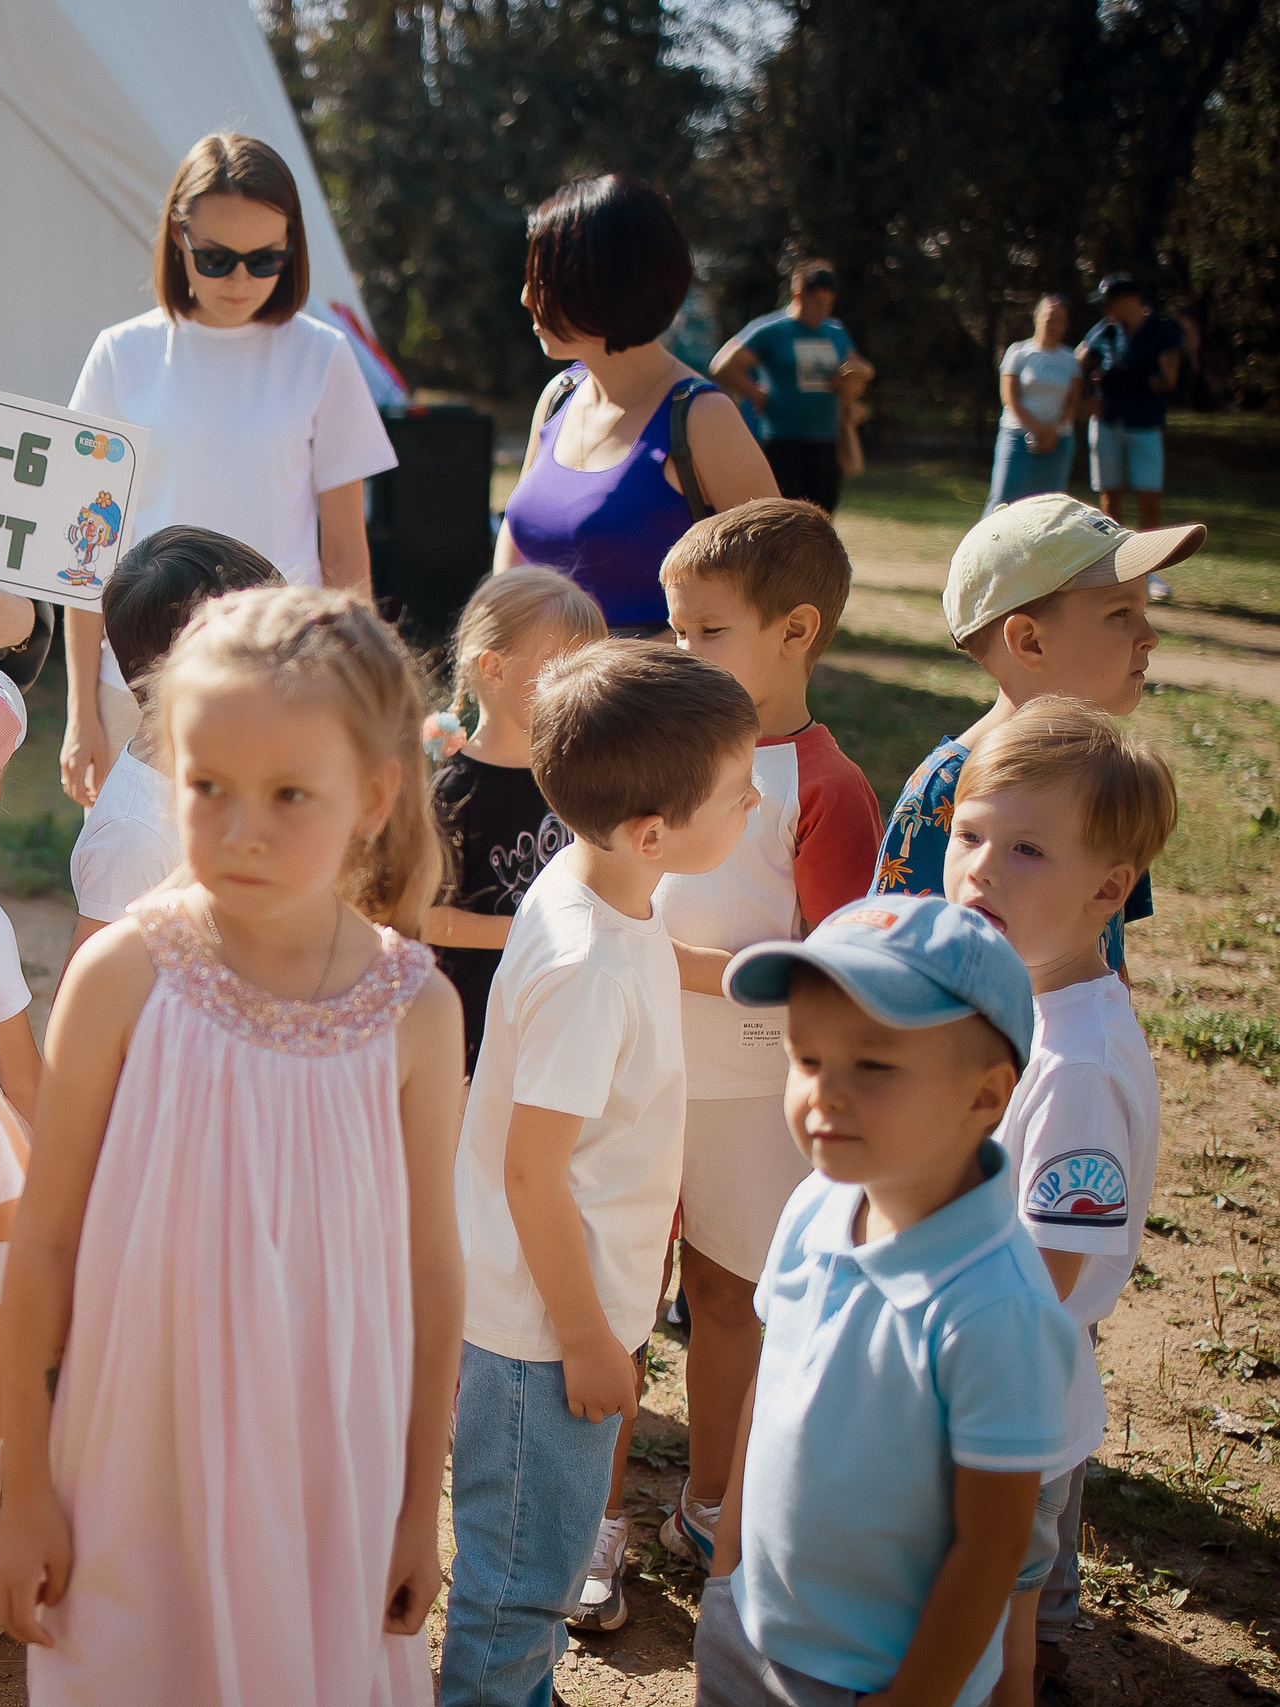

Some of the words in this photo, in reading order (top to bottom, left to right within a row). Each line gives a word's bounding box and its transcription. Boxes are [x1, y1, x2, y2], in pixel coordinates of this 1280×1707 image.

[79, 437, 102, 449] КВЕСТ
[1032, 1171, 1061, 1208] TOP
[1066, 1158, 1124, 1203] SPEED
